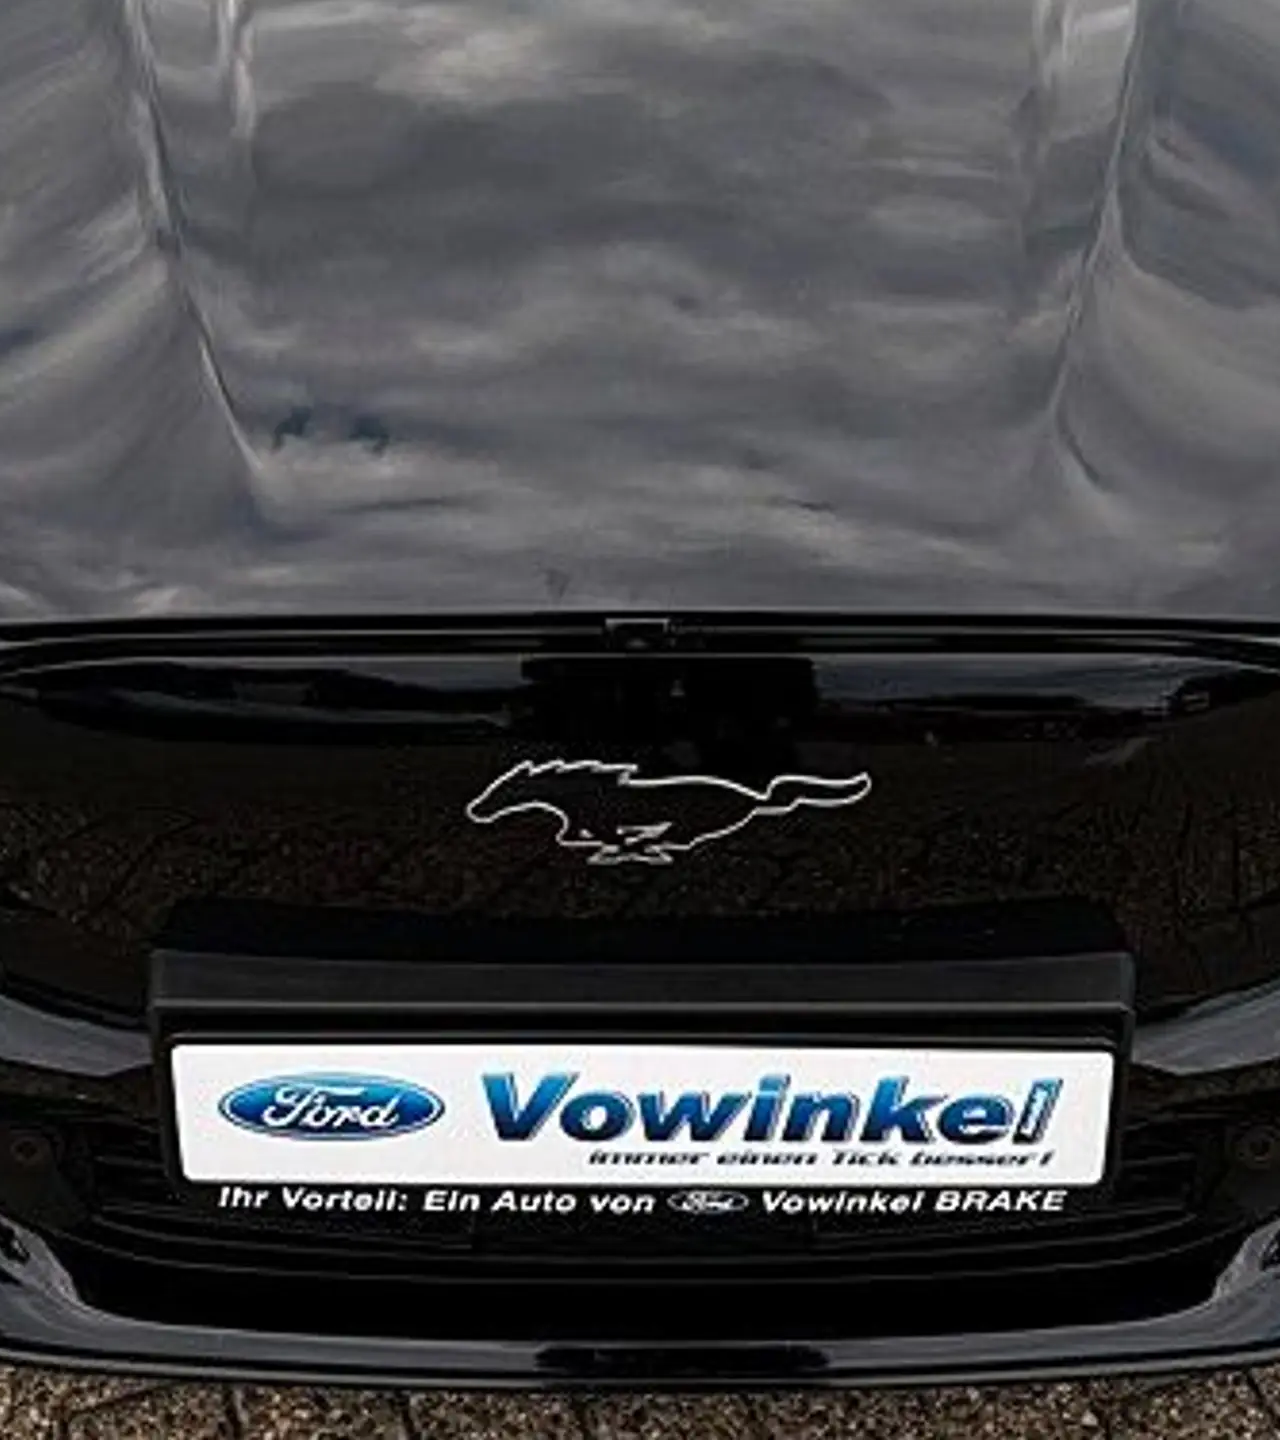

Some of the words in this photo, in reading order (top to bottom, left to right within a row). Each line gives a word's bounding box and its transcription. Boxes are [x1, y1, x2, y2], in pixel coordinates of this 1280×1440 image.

[260, 1082, 401, 1130] Ford
[482, 1070, 1064, 1145] Vowinkel
[219, 1186, 269, 1209] Ihr
[282, 1187, 408, 1211] Vorteil:
[422, 1189, 481, 1211] Ein
[491, 1190, 577, 1213] Auto
[589, 1195, 656, 1213] von
[761, 1189, 924, 1213] Vowinkel
[934, 1190, 1068, 1212] BRAKE
